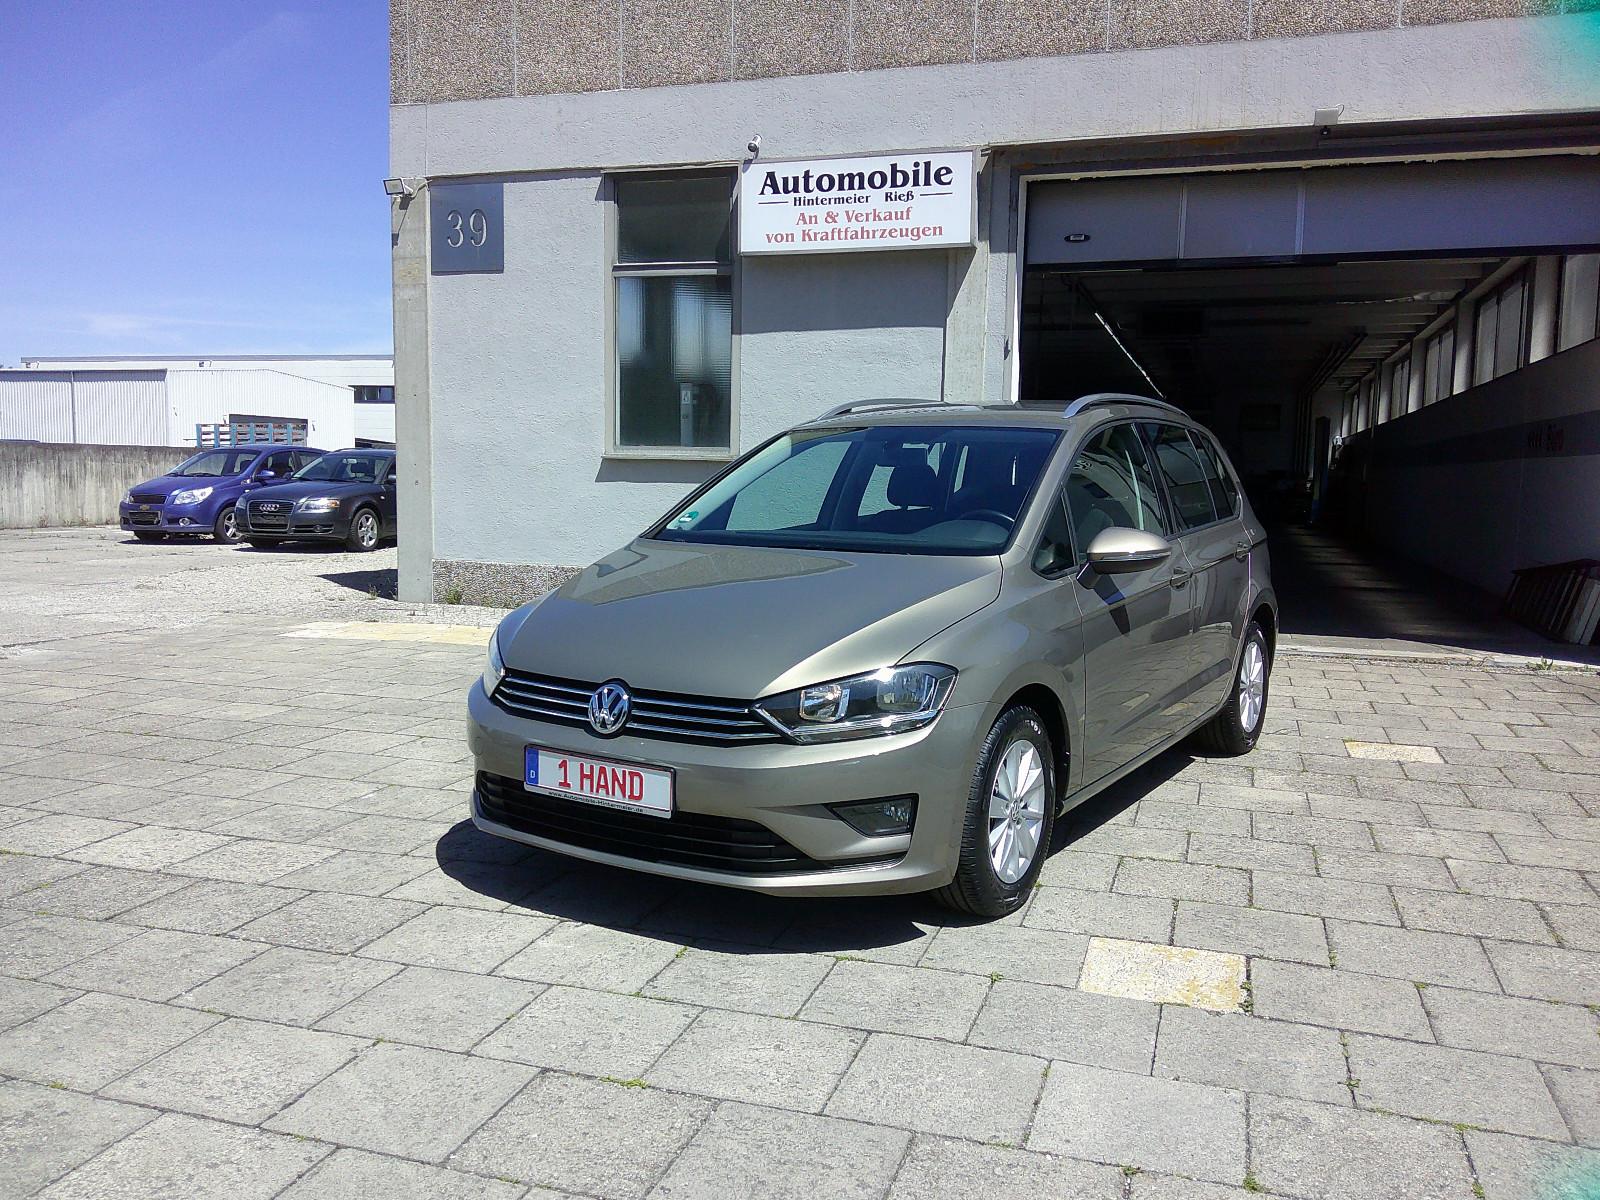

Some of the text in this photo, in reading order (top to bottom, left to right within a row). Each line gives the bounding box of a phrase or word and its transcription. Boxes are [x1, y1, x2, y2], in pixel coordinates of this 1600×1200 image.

[758, 160, 953, 195] Automobile
[793, 190, 914, 207] Hintermeier Rieß
[795, 206, 913, 226] An & Verkauf
[447, 208, 487, 248] 39
[765, 223, 943, 244] von Kraftfahrzeugen
[529, 769, 536, 779] D
[557, 759, 644, 801] 1 HAND
